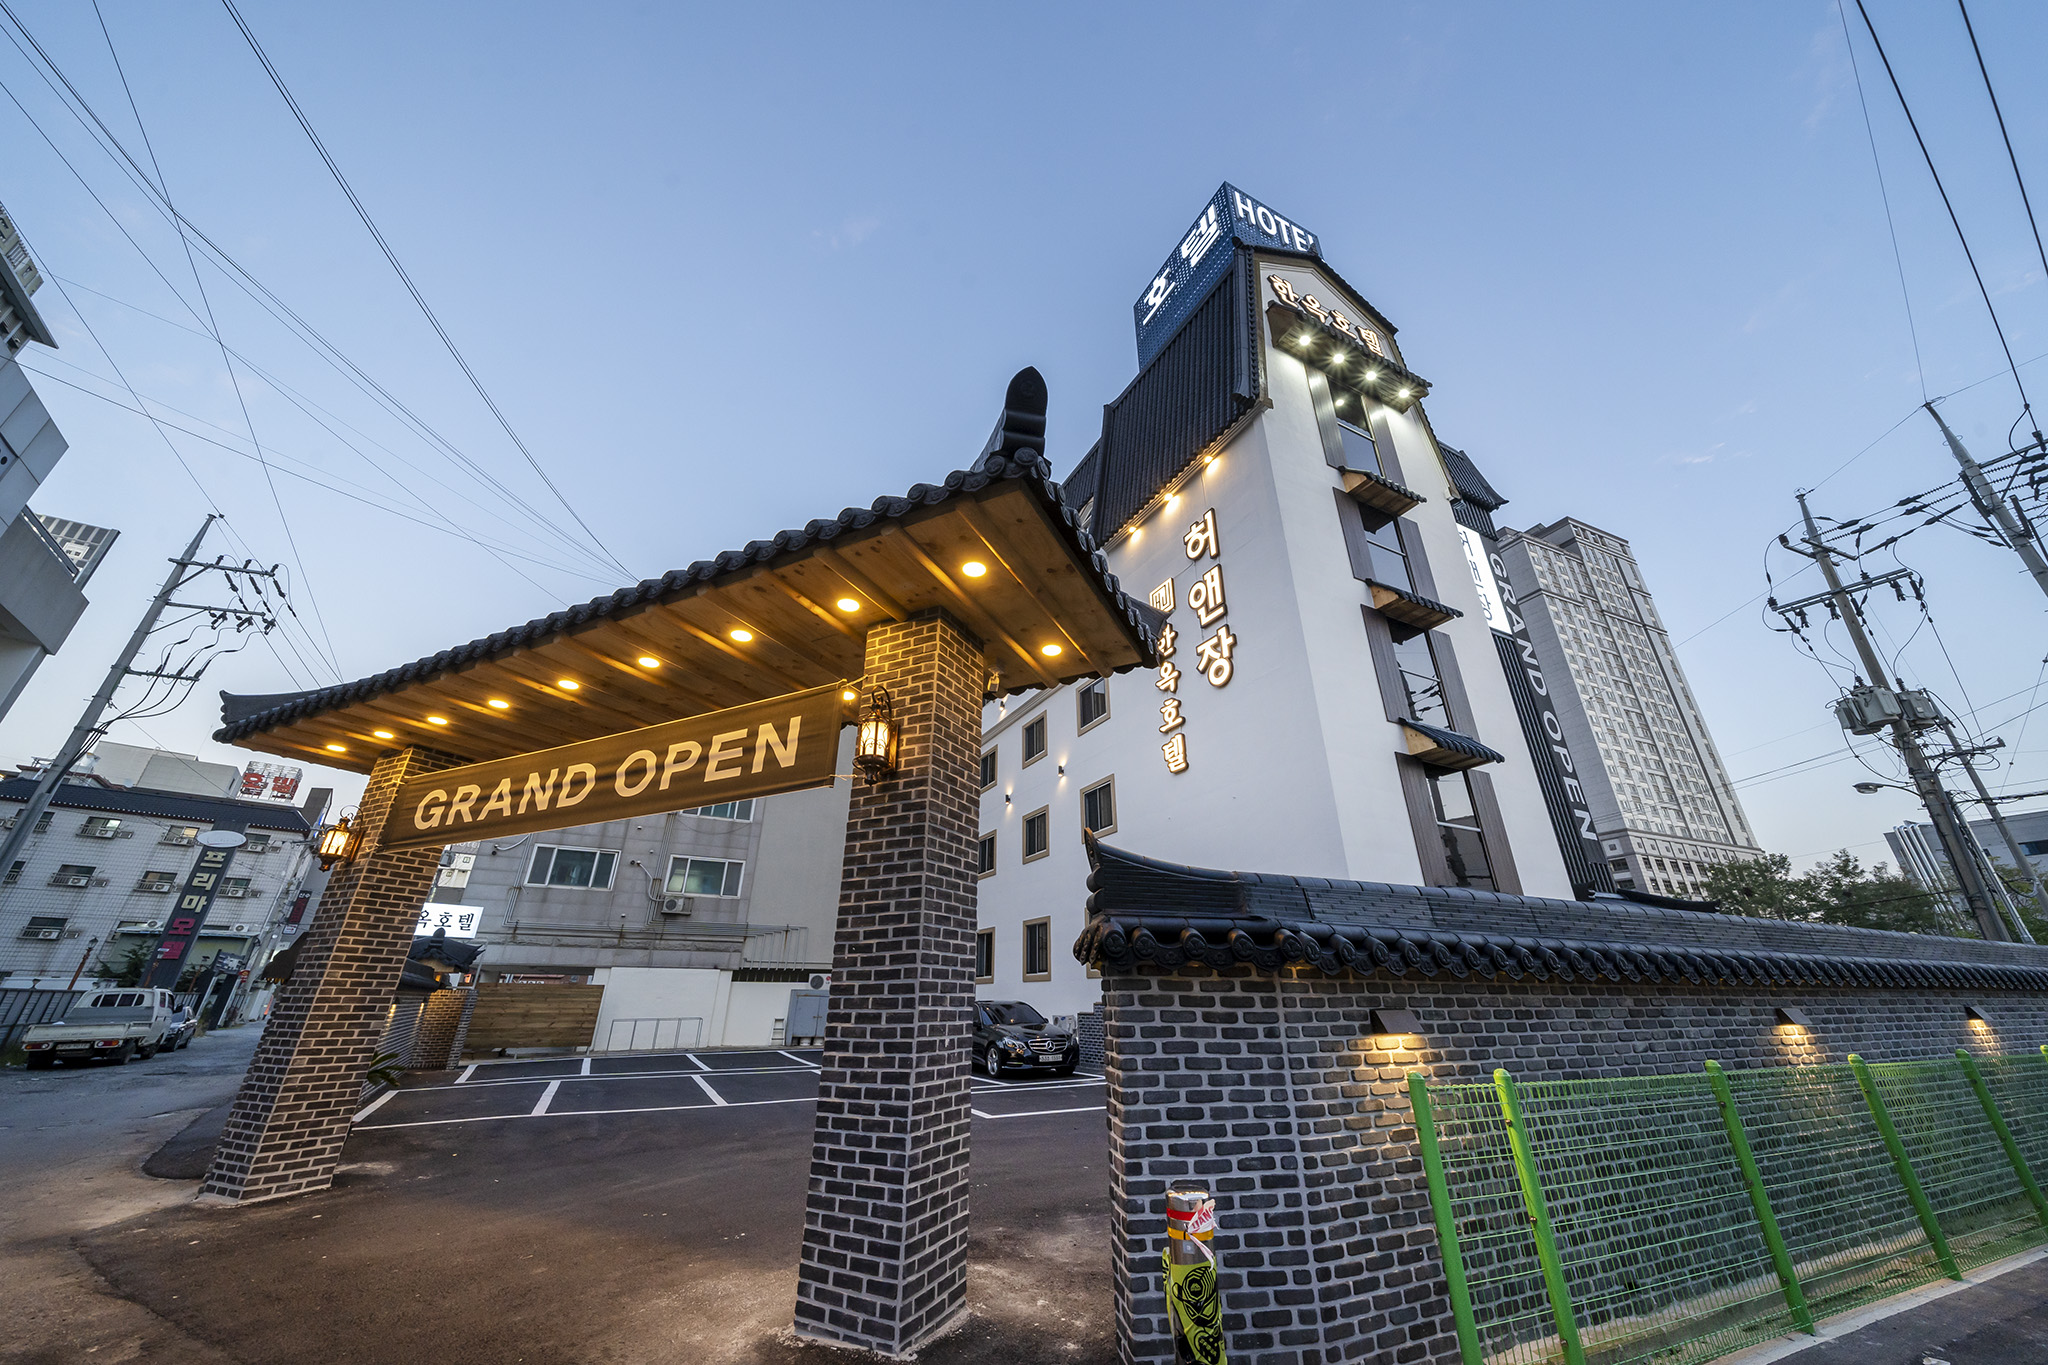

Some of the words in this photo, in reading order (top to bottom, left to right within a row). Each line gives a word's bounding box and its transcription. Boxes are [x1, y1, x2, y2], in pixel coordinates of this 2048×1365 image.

[1143, 204, 1221, 326] 호텔
[1267, 274, 1384, 357] 한옥호텔
[1183, 507, 1237, 688] 허앤장
[1489, 552, 1550, 697] GRAND
[1541, 709, 1598, 841] OPEN
[413, 762, 597, 830] GRAND
[613, 715, 802, 797] OPEN
